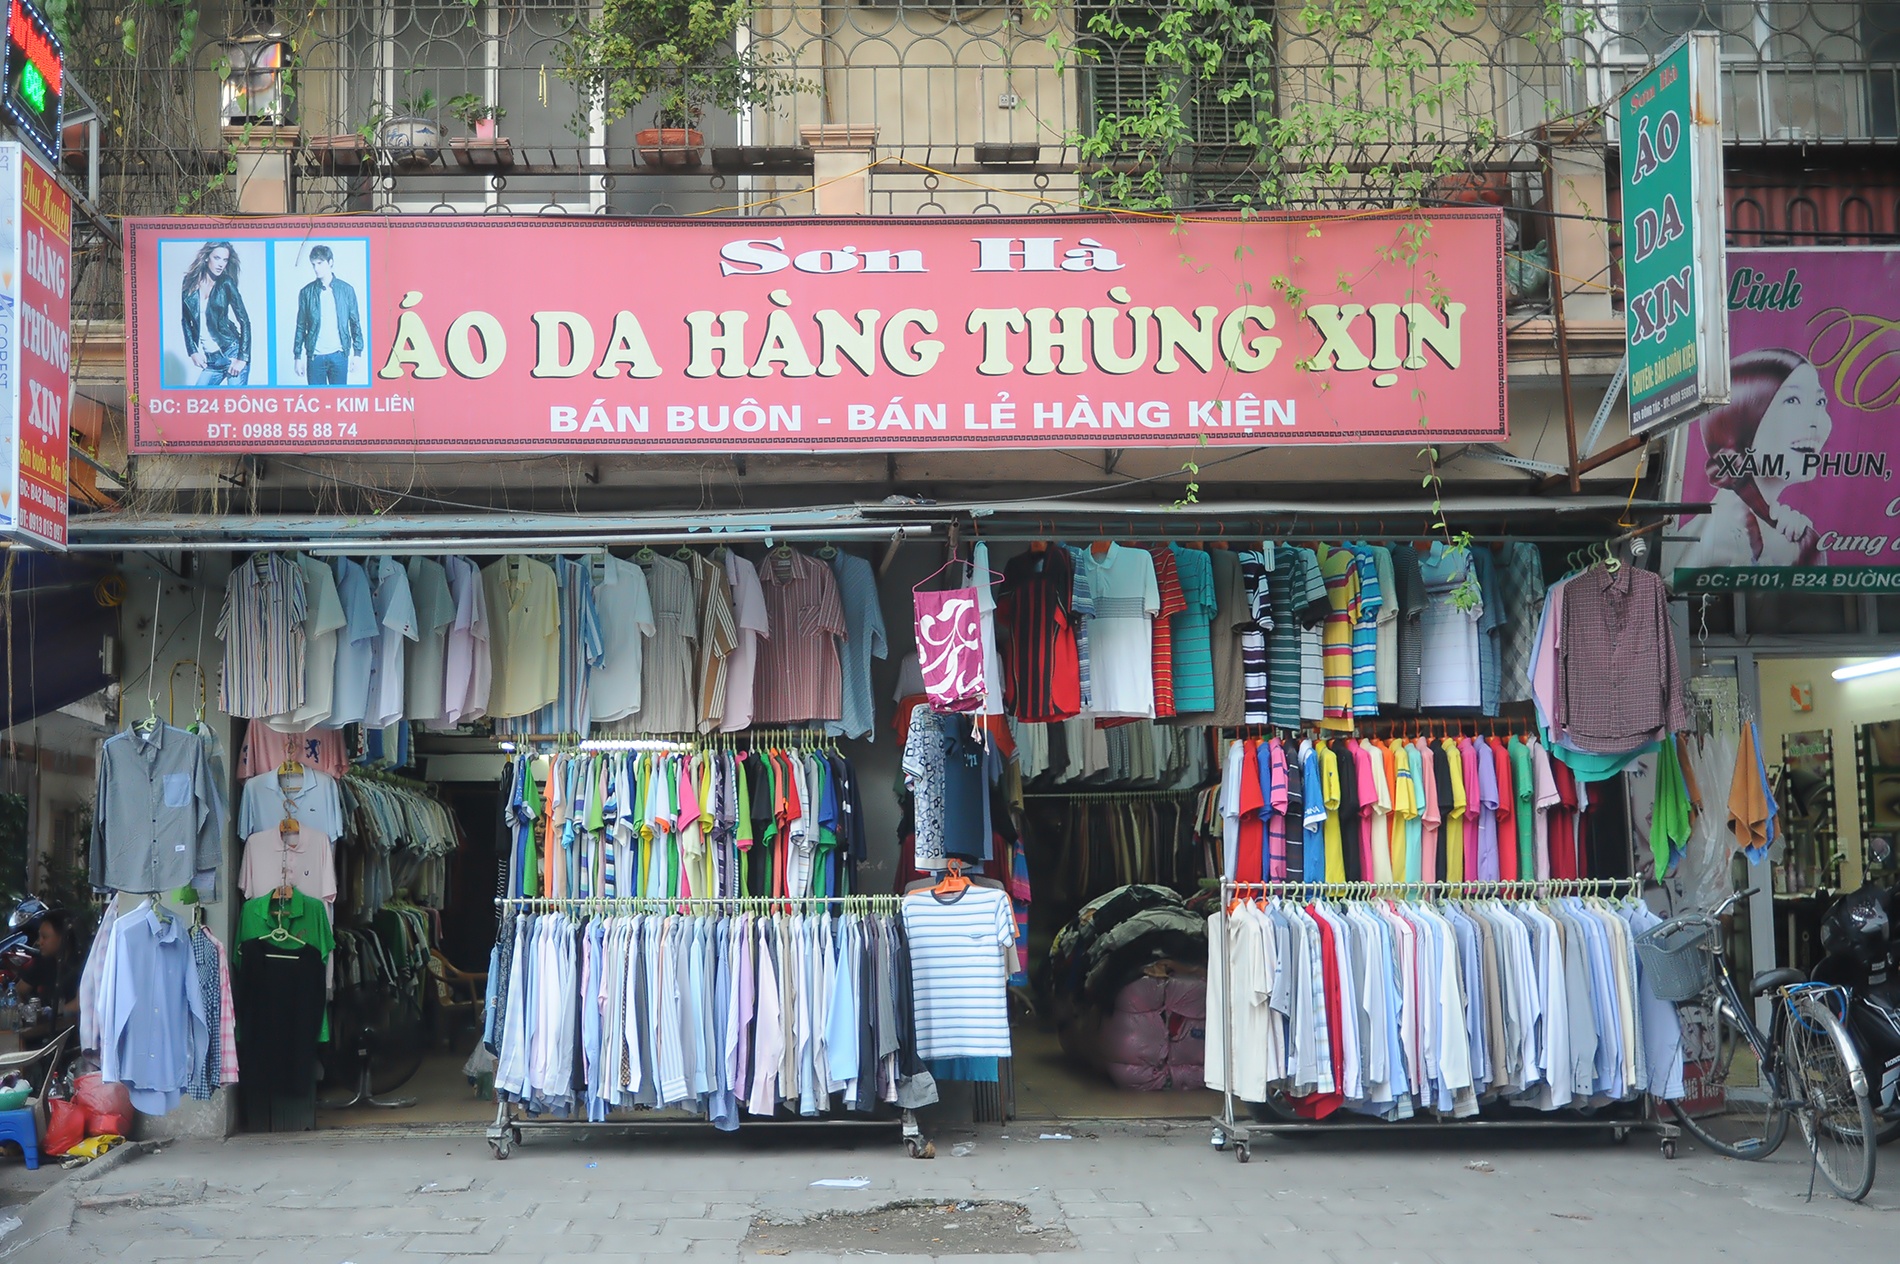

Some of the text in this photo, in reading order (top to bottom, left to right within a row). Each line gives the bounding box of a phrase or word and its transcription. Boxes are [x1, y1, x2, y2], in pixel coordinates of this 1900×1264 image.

[1632, 110, 1681, 185] ÁO
[23, 161, 41, 211] Thu
[1633, 193, 1685, 264] DA
[27, 226, 65, 299] HÀNG
[719, 237, 1126, 277] Sơn Hà
[1630, 265, 1692, 346] XỊN
[1727, 267, 1803, 312] Linh
[22, 301, 69, 374] THÙNG
[377, 286, 1468, 388] ÁO DA HÀNG THÙNG XỊN
[28, 379, 62, 444] XỊN
[149, 399, 181, 414] ĐC:
[187, 399, 219, 413] B24
[224, 394, 280, 413] ĐÔNG
[283, 394, 320, 413] TÁC
[336, 397, 369, 412] KIM
[374, 394, 414, 412] LIÊN
[550, 399, 648, 433] BÁN
[666, 397, 801, 433] BUÔN
[846, 396, 948, 431] BÁN
[963, 391, 1017, 430] LẺ
[1033, 394, 1170, 429] HÀNG
[1188, 391, 1297, 434] KIỆN
[207, 422, 358, 439] ĐT: 0988 55 88 74
[20, 438, 31, 468] Bán
[32, 445, 47, 475] buôn
[51, 455, 62, 483] Bán
[1716, 448, 1892, 481] XĂM, PHUN,
[1816, 530, 1887, 557] Cung
[1696, 568, 1900, 589] ĐC: P101, B24 ĐƯỜNG
